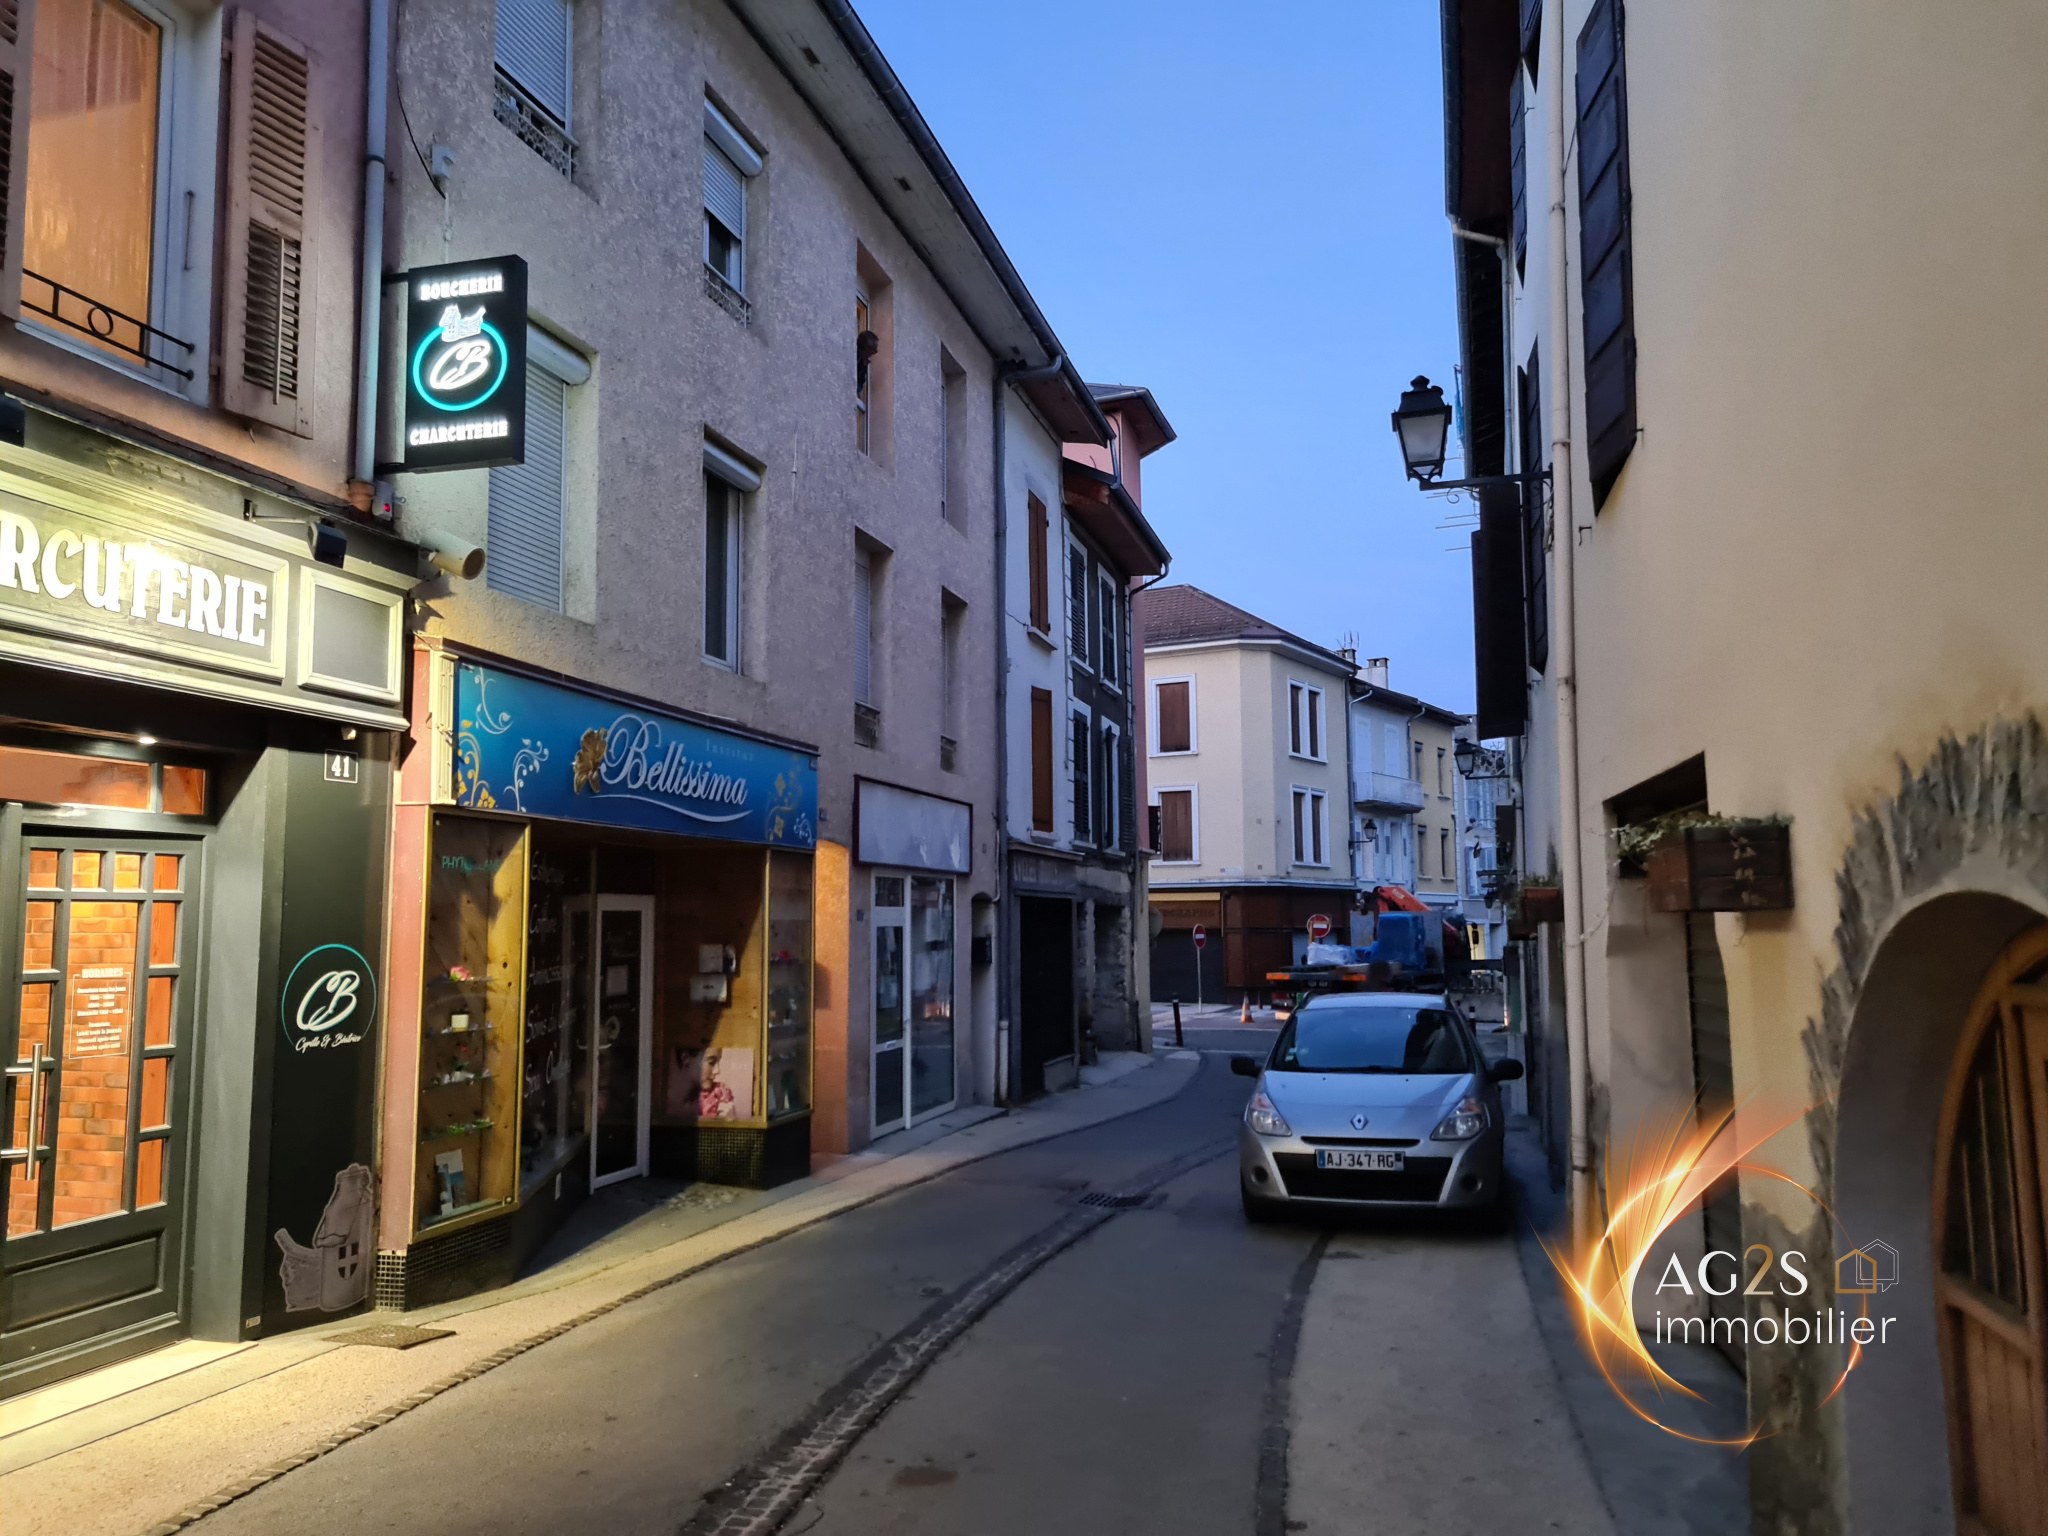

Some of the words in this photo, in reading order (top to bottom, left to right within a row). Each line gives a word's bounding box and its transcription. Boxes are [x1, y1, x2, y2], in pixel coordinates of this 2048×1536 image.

[420, 274, 503, 301] BOUCHERIE
[429, 339, 491, 390] CB
[409, 419, 509, 446] CHARCUTERIE
[0, 510, 268, 647] RCUTERIE
[331, 754, 350, 778] 41
[600, 713, 748, 806] Bellissima
[81, 967, 124, 979] HORAIRES
[296, 970, 360, 1032] CB
